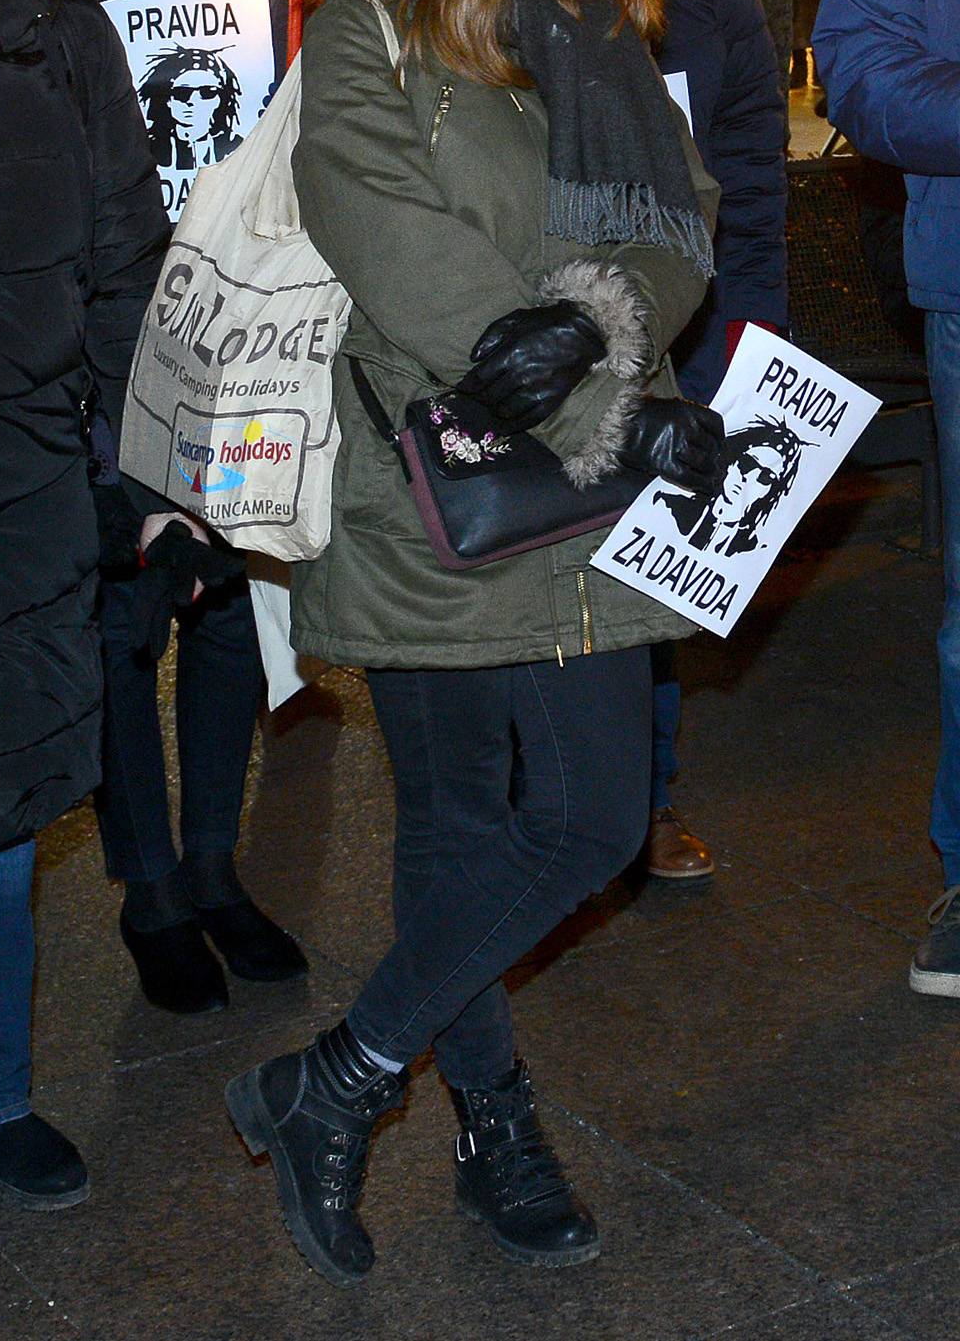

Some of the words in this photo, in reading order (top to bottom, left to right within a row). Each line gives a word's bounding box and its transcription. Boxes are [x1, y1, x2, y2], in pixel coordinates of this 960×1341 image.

[127, 3, 240, 43] PRAVDA
[153, 342, 180, 377] Luxury
[178, 366, 218, 401] Camping
[220, 379, 300, 398] Holidays
[756, 357, 849, 437] PRAVDA
[176, 431, 215, 470] Suncamp
[220, 437, 292, 465] holidays
[611, 527, 656, 574] ZA
[648, 544, 739, 621] DAVIDA
